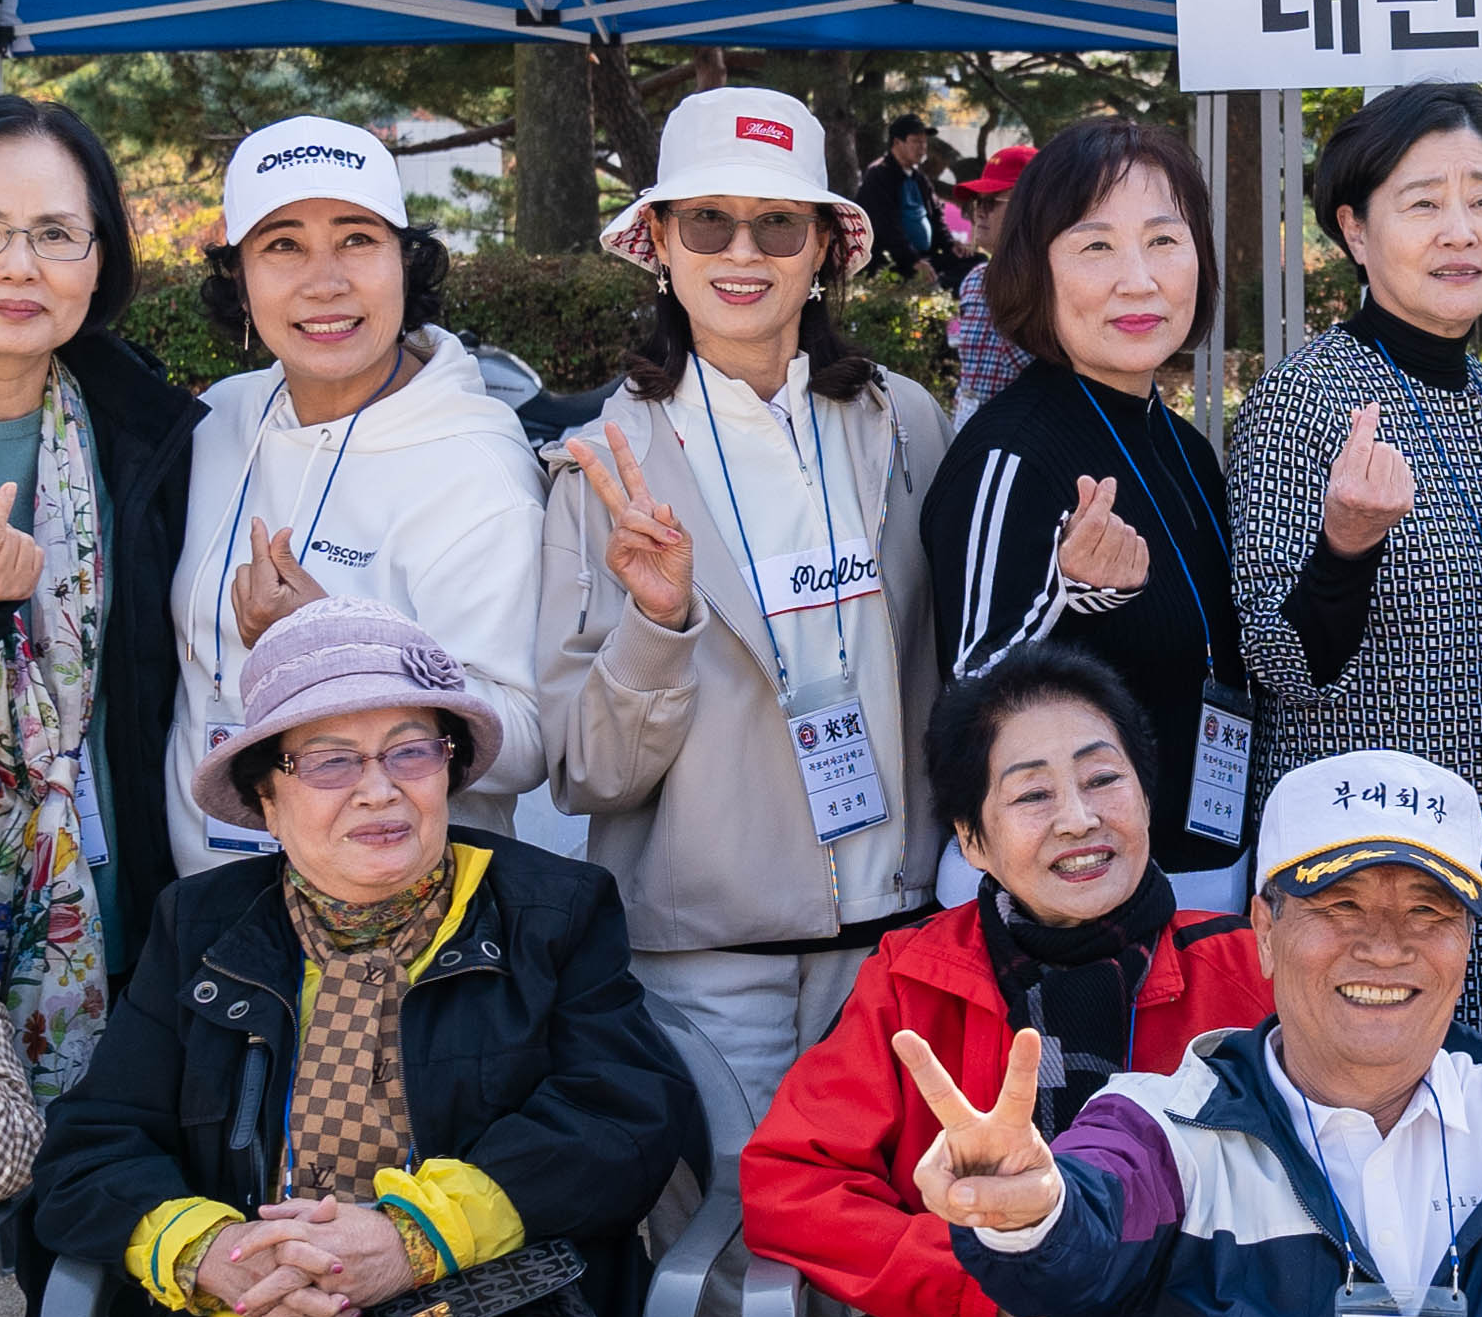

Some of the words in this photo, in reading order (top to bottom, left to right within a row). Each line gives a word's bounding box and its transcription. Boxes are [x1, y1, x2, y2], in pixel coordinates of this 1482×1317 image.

[790, 554, 878, 594] Malbo
[808, 748, 865, 772] 목포여자고등학교
[1332, 781, 1447, 824] 부대회장
